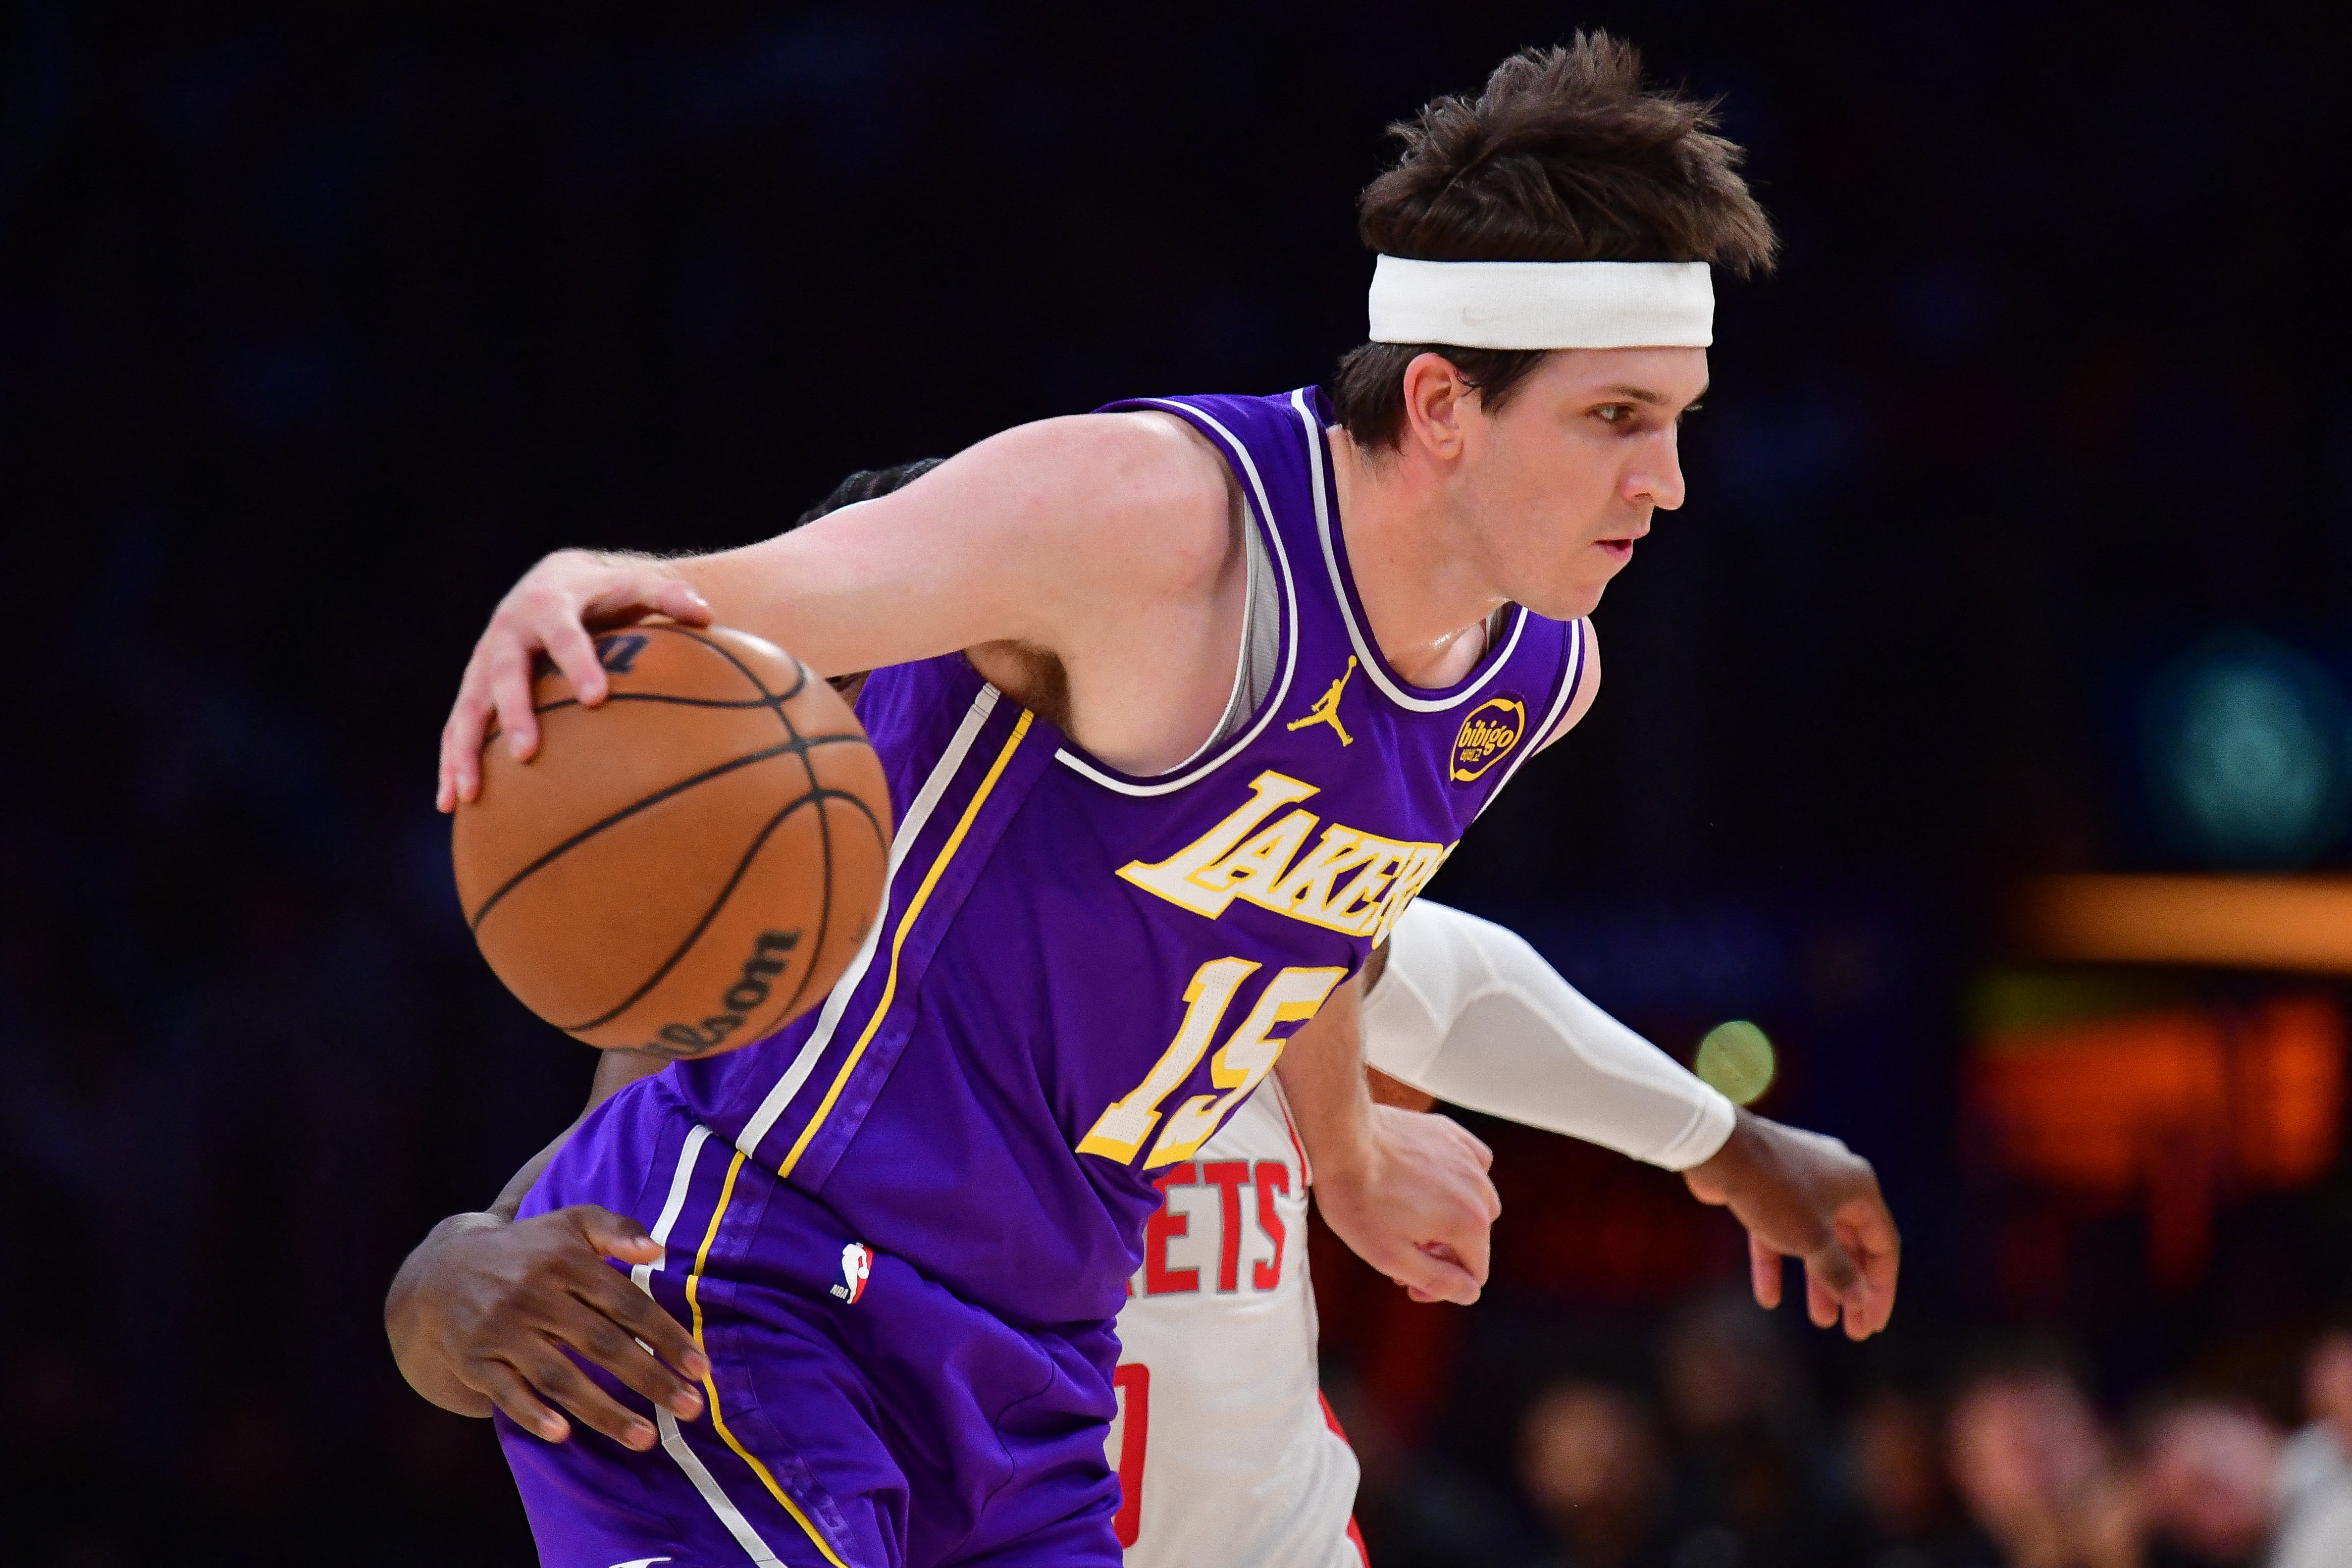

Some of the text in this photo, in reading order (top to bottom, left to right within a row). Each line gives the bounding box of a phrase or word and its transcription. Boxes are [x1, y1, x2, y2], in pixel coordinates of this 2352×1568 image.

[1458, 720, 1514, 756] bibigo
[1075, 956, 1349, 1170] 15
[830, 1284, 849, 1300] NBA
